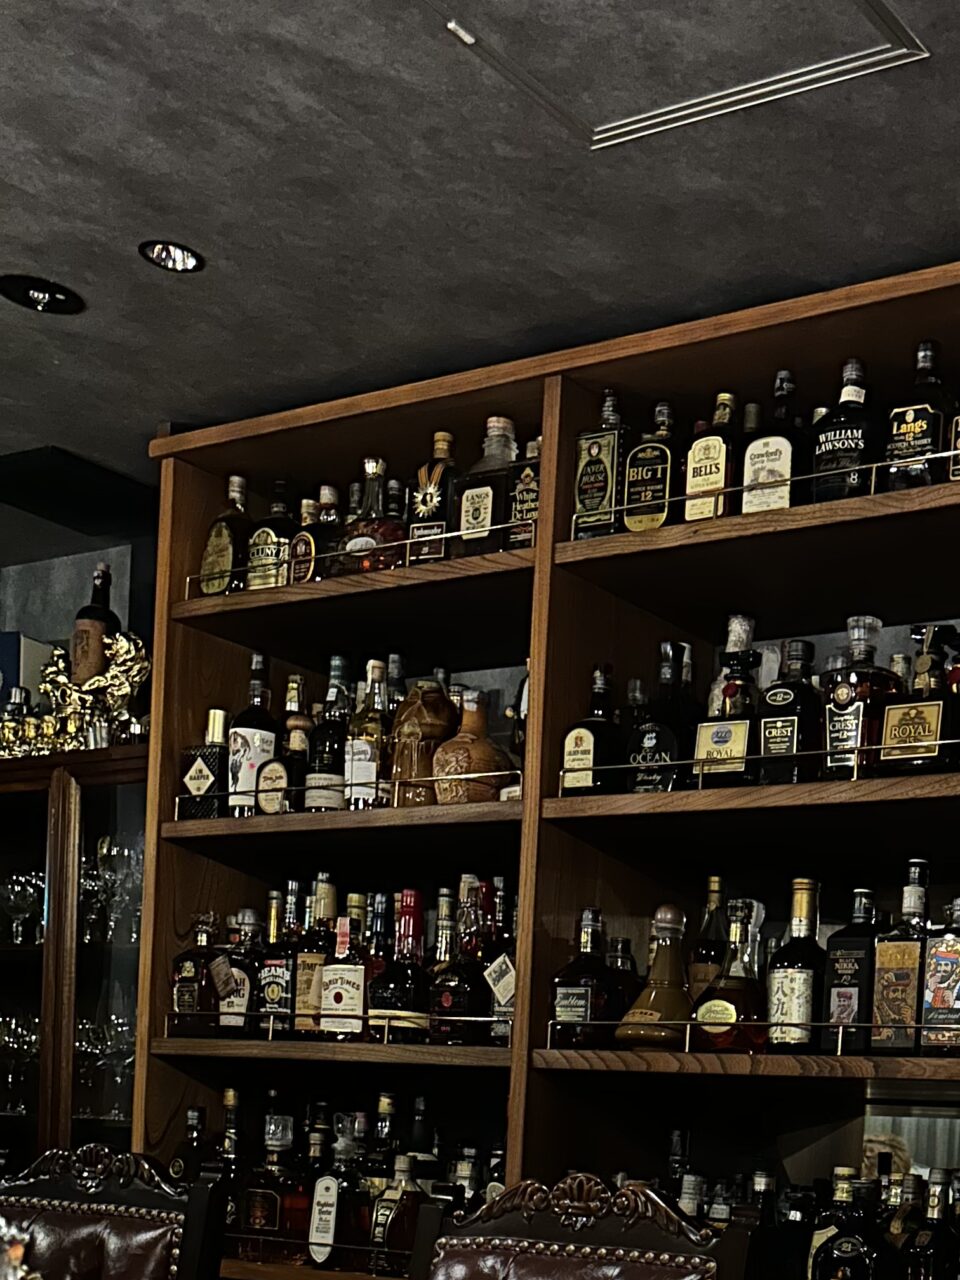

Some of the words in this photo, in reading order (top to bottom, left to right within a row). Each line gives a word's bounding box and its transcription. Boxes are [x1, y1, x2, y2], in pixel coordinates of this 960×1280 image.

[892, 419, 928, 435] Langs
[818, 429, 863, 443] WILLIAM
[815, 439, 865, 455] LAWSON'S
[629, 466, 653, 481] BIG
[692, 462, 720, 478] BELL'S
[849, 471, 859, 484] 8
[466, 491, 490, 502] LANGS
[640, 490, 653, 501] 12
[765, 727, 793, 737] CREST
[829, 720, 859, 731] CREST
[890, 724, 933, 739] ROYAL
[629, 752, 672, 766] OCEAN
[706, 748, 736, 759] ROYAL
[834, 962, 860, 971] NIKKA
[338, 976, 361, 992] TIMES
